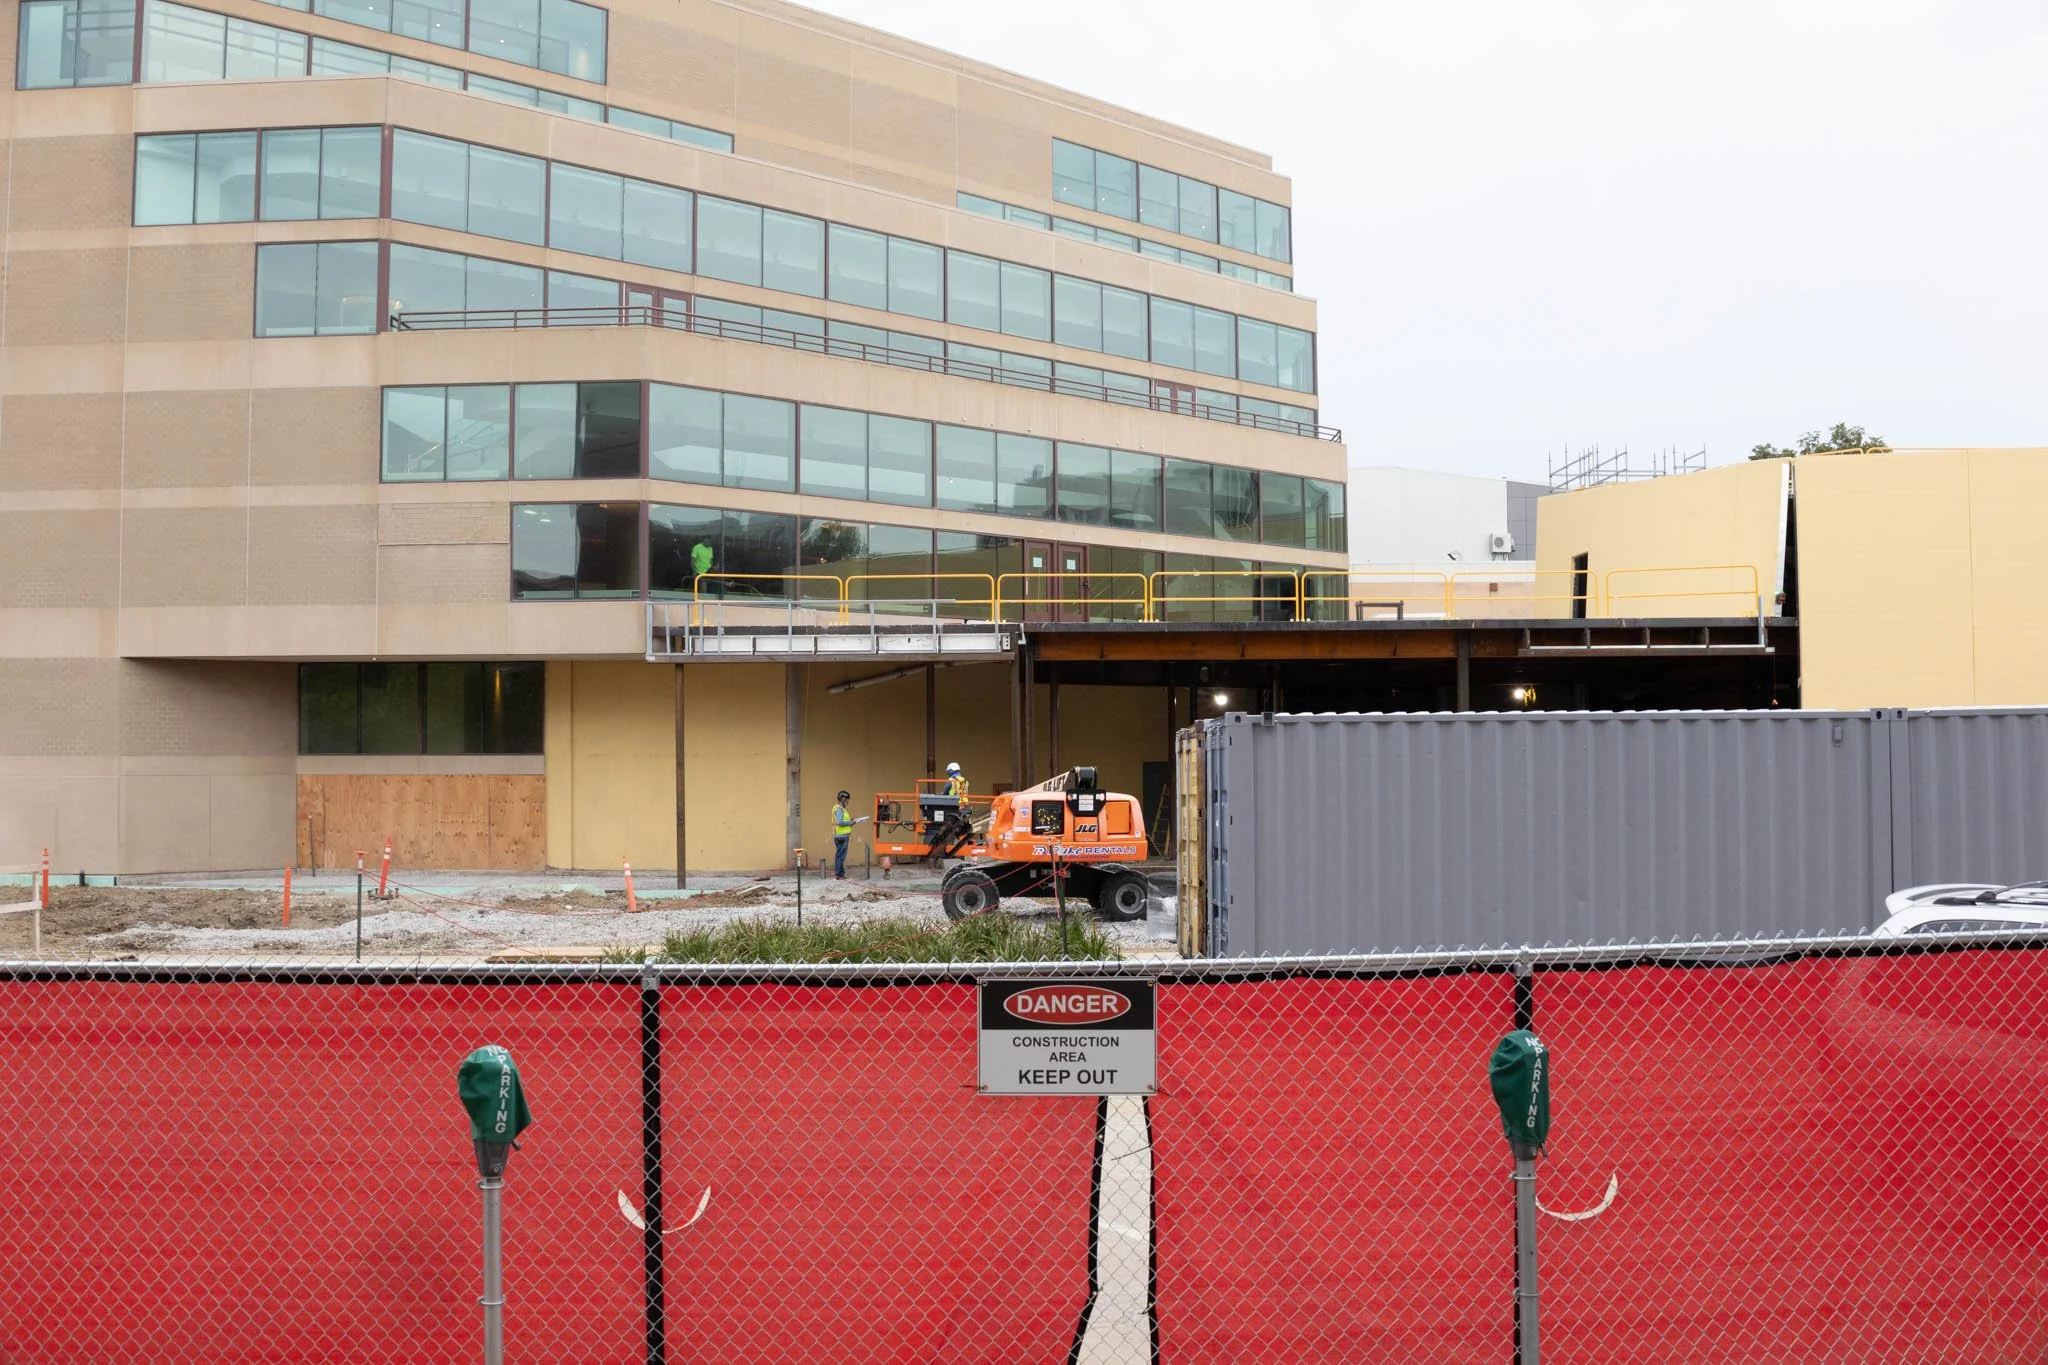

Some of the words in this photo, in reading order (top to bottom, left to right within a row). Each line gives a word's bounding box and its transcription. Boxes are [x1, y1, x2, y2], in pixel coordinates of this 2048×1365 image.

[1075, 824, 1098, 833] JLG
[1085, 846, 1137, 855] RENTALS
[1016, 994, 1119, 1014] DANGER
[1012, 1036, 1120, 1048] CONSTRUCTION
[1524, 1037, 1544, 1048] NO
[486, 1046, 508, 1057] NO
[1049, 1051, 1087, 1063] AREA
[1018, 1069, 1071, 1085] KEEP
[1077, 1069, 1118, 1085] OUT
[1526, 1047, 1544, 1128] PARKING
[495, 1055, 512, 1134] PARKING
